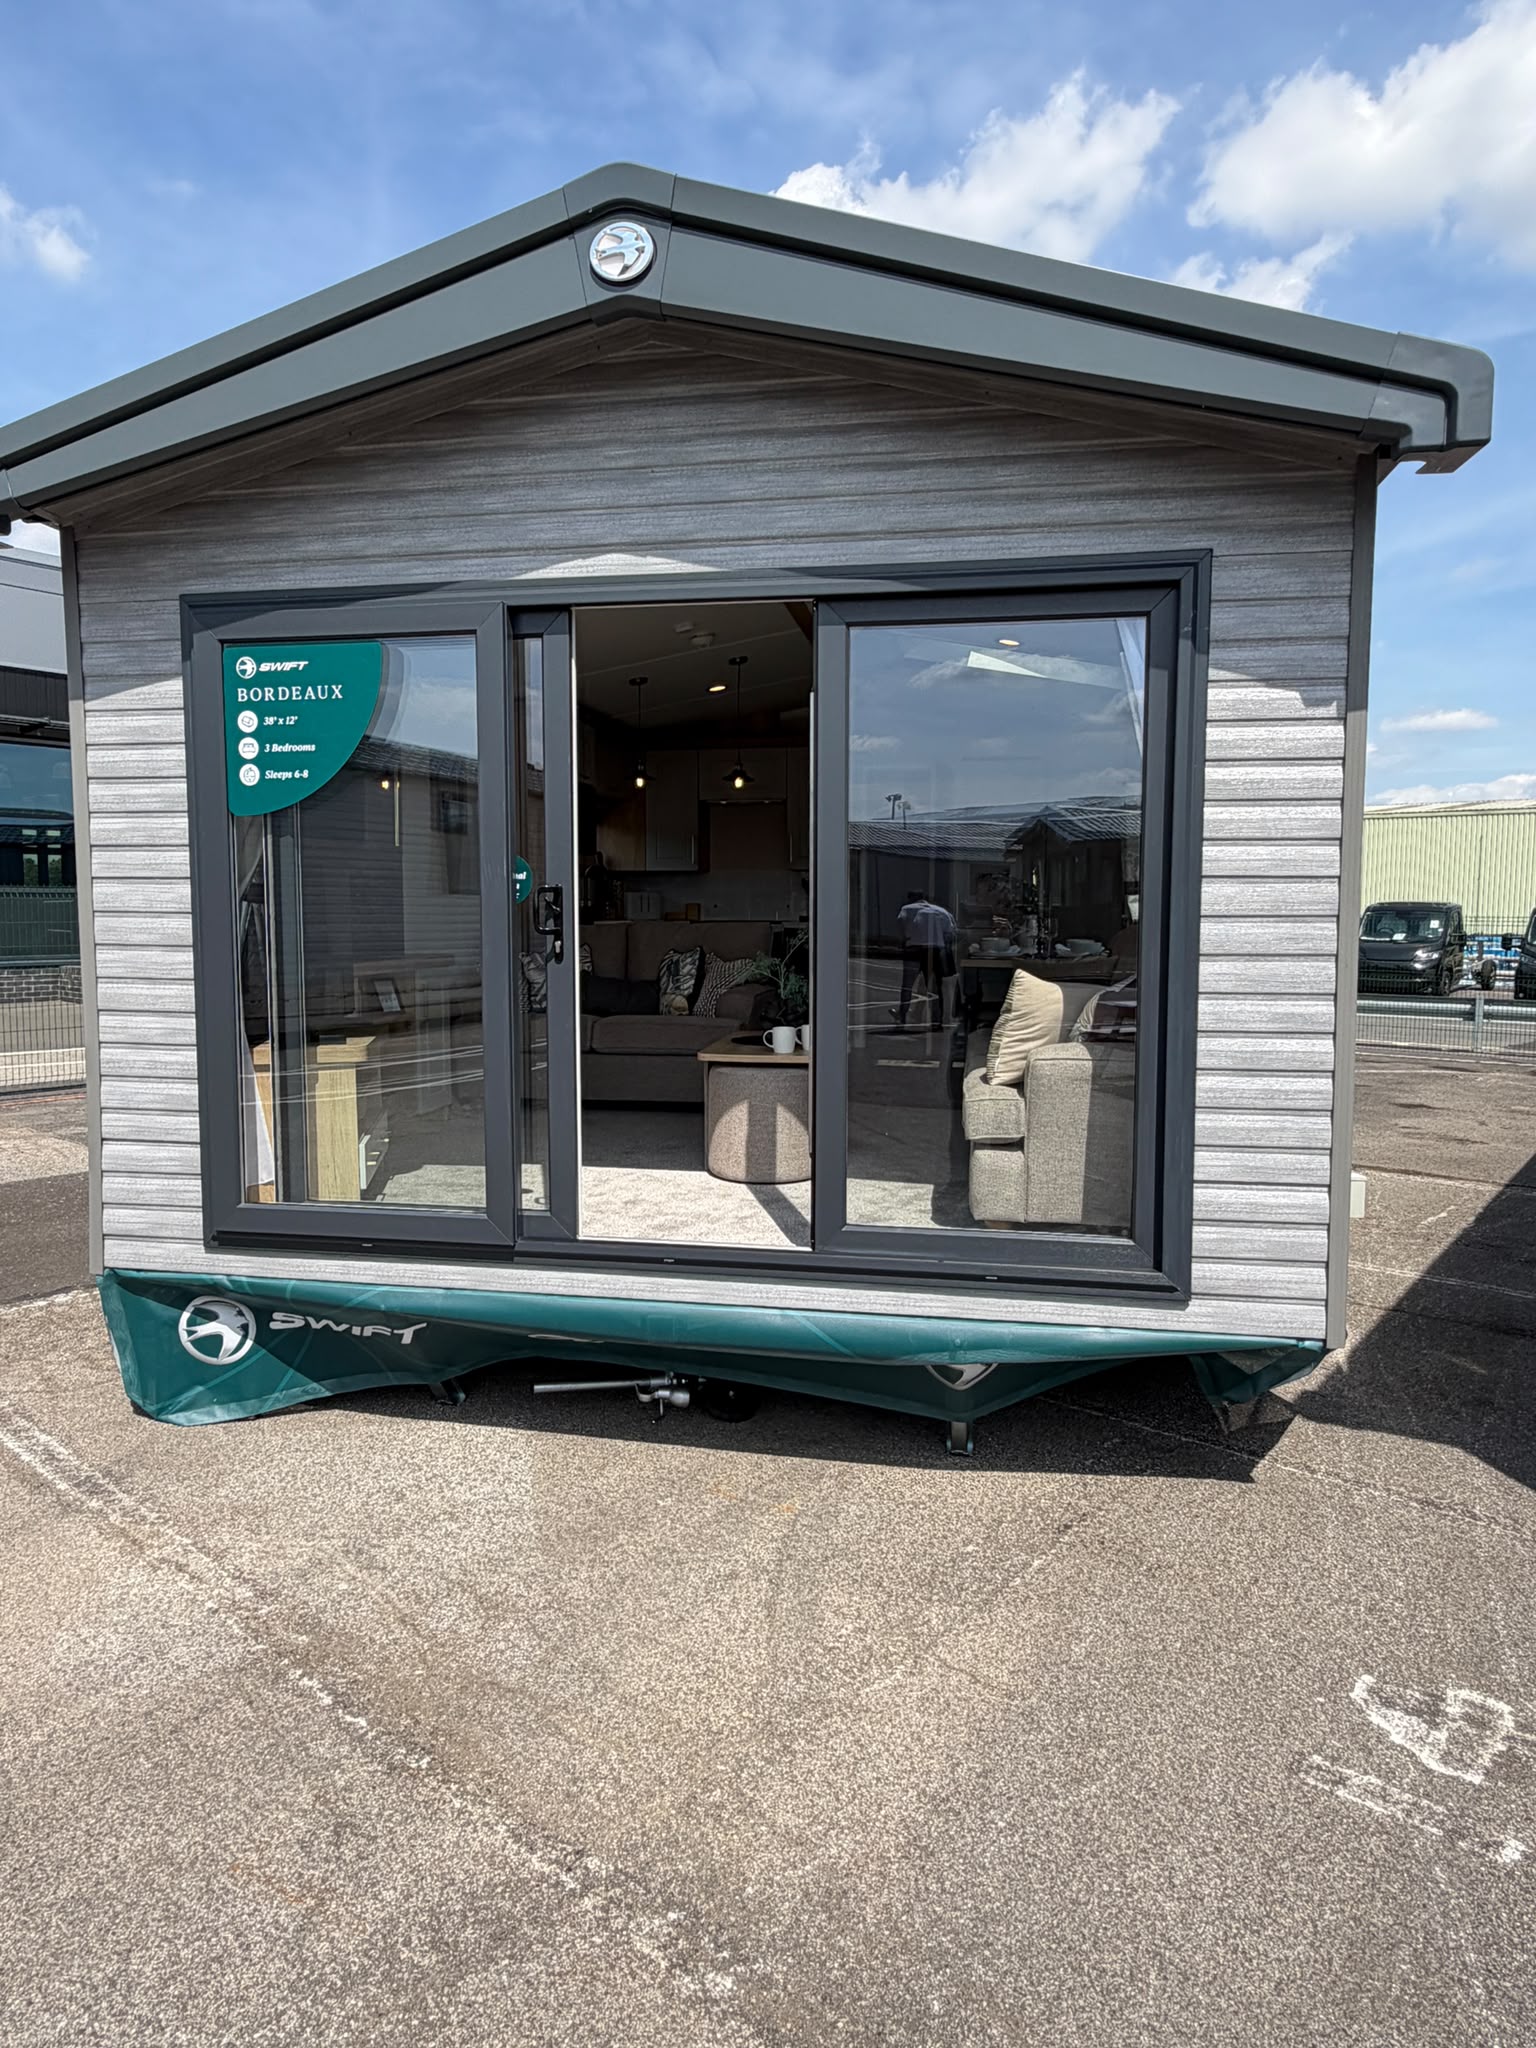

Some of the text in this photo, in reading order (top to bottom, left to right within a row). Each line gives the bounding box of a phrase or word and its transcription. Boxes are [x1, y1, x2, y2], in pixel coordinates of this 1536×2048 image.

[258, 661, 309, 672] SWIFT
[237, 685, 343, 702] BORDEAUX
[263, 743, 316, 753] 3 Bedrooms
[264, 769, 309, 781] Sleeps 6-8
[269, 1312, 428, 1345] SWIFT
